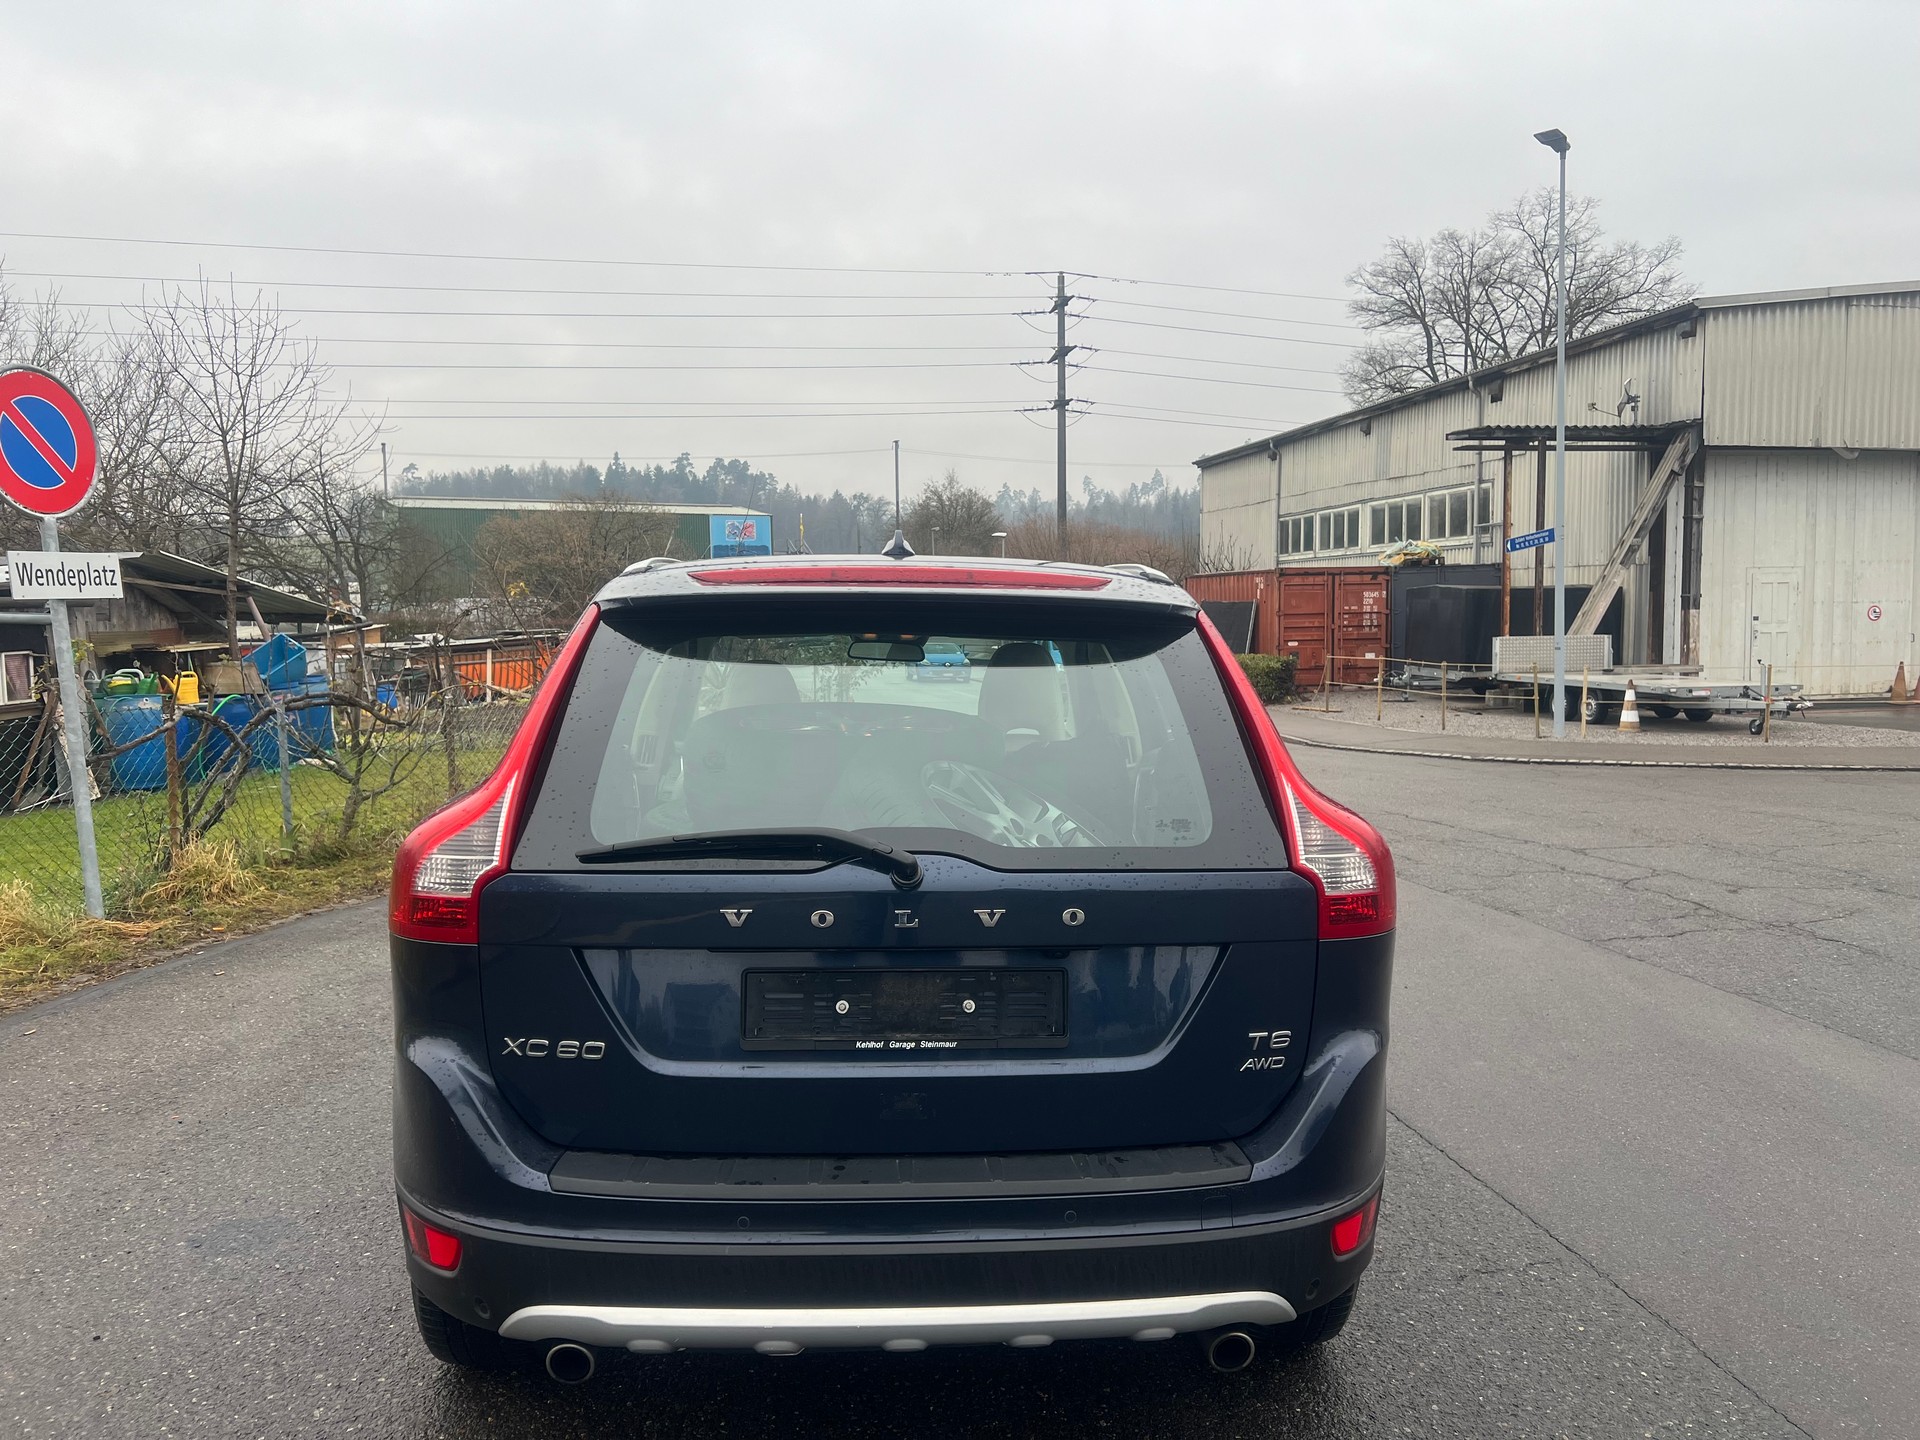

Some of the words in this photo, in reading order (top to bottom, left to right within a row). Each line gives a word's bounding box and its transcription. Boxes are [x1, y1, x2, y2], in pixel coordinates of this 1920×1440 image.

[15, 561, 117, 593] Wendeplatz
[719, 907, 1086, 929] VOLVO
[855, 1041, 884, 1049] Kehlhof
[889, 1041, 916, 1050] Garage
[920, 1041, 957, 1049] Steinmaur
[1248, 1030, 1292, 1050] T6
[1239, 1056, 1286, 1072] AWD
